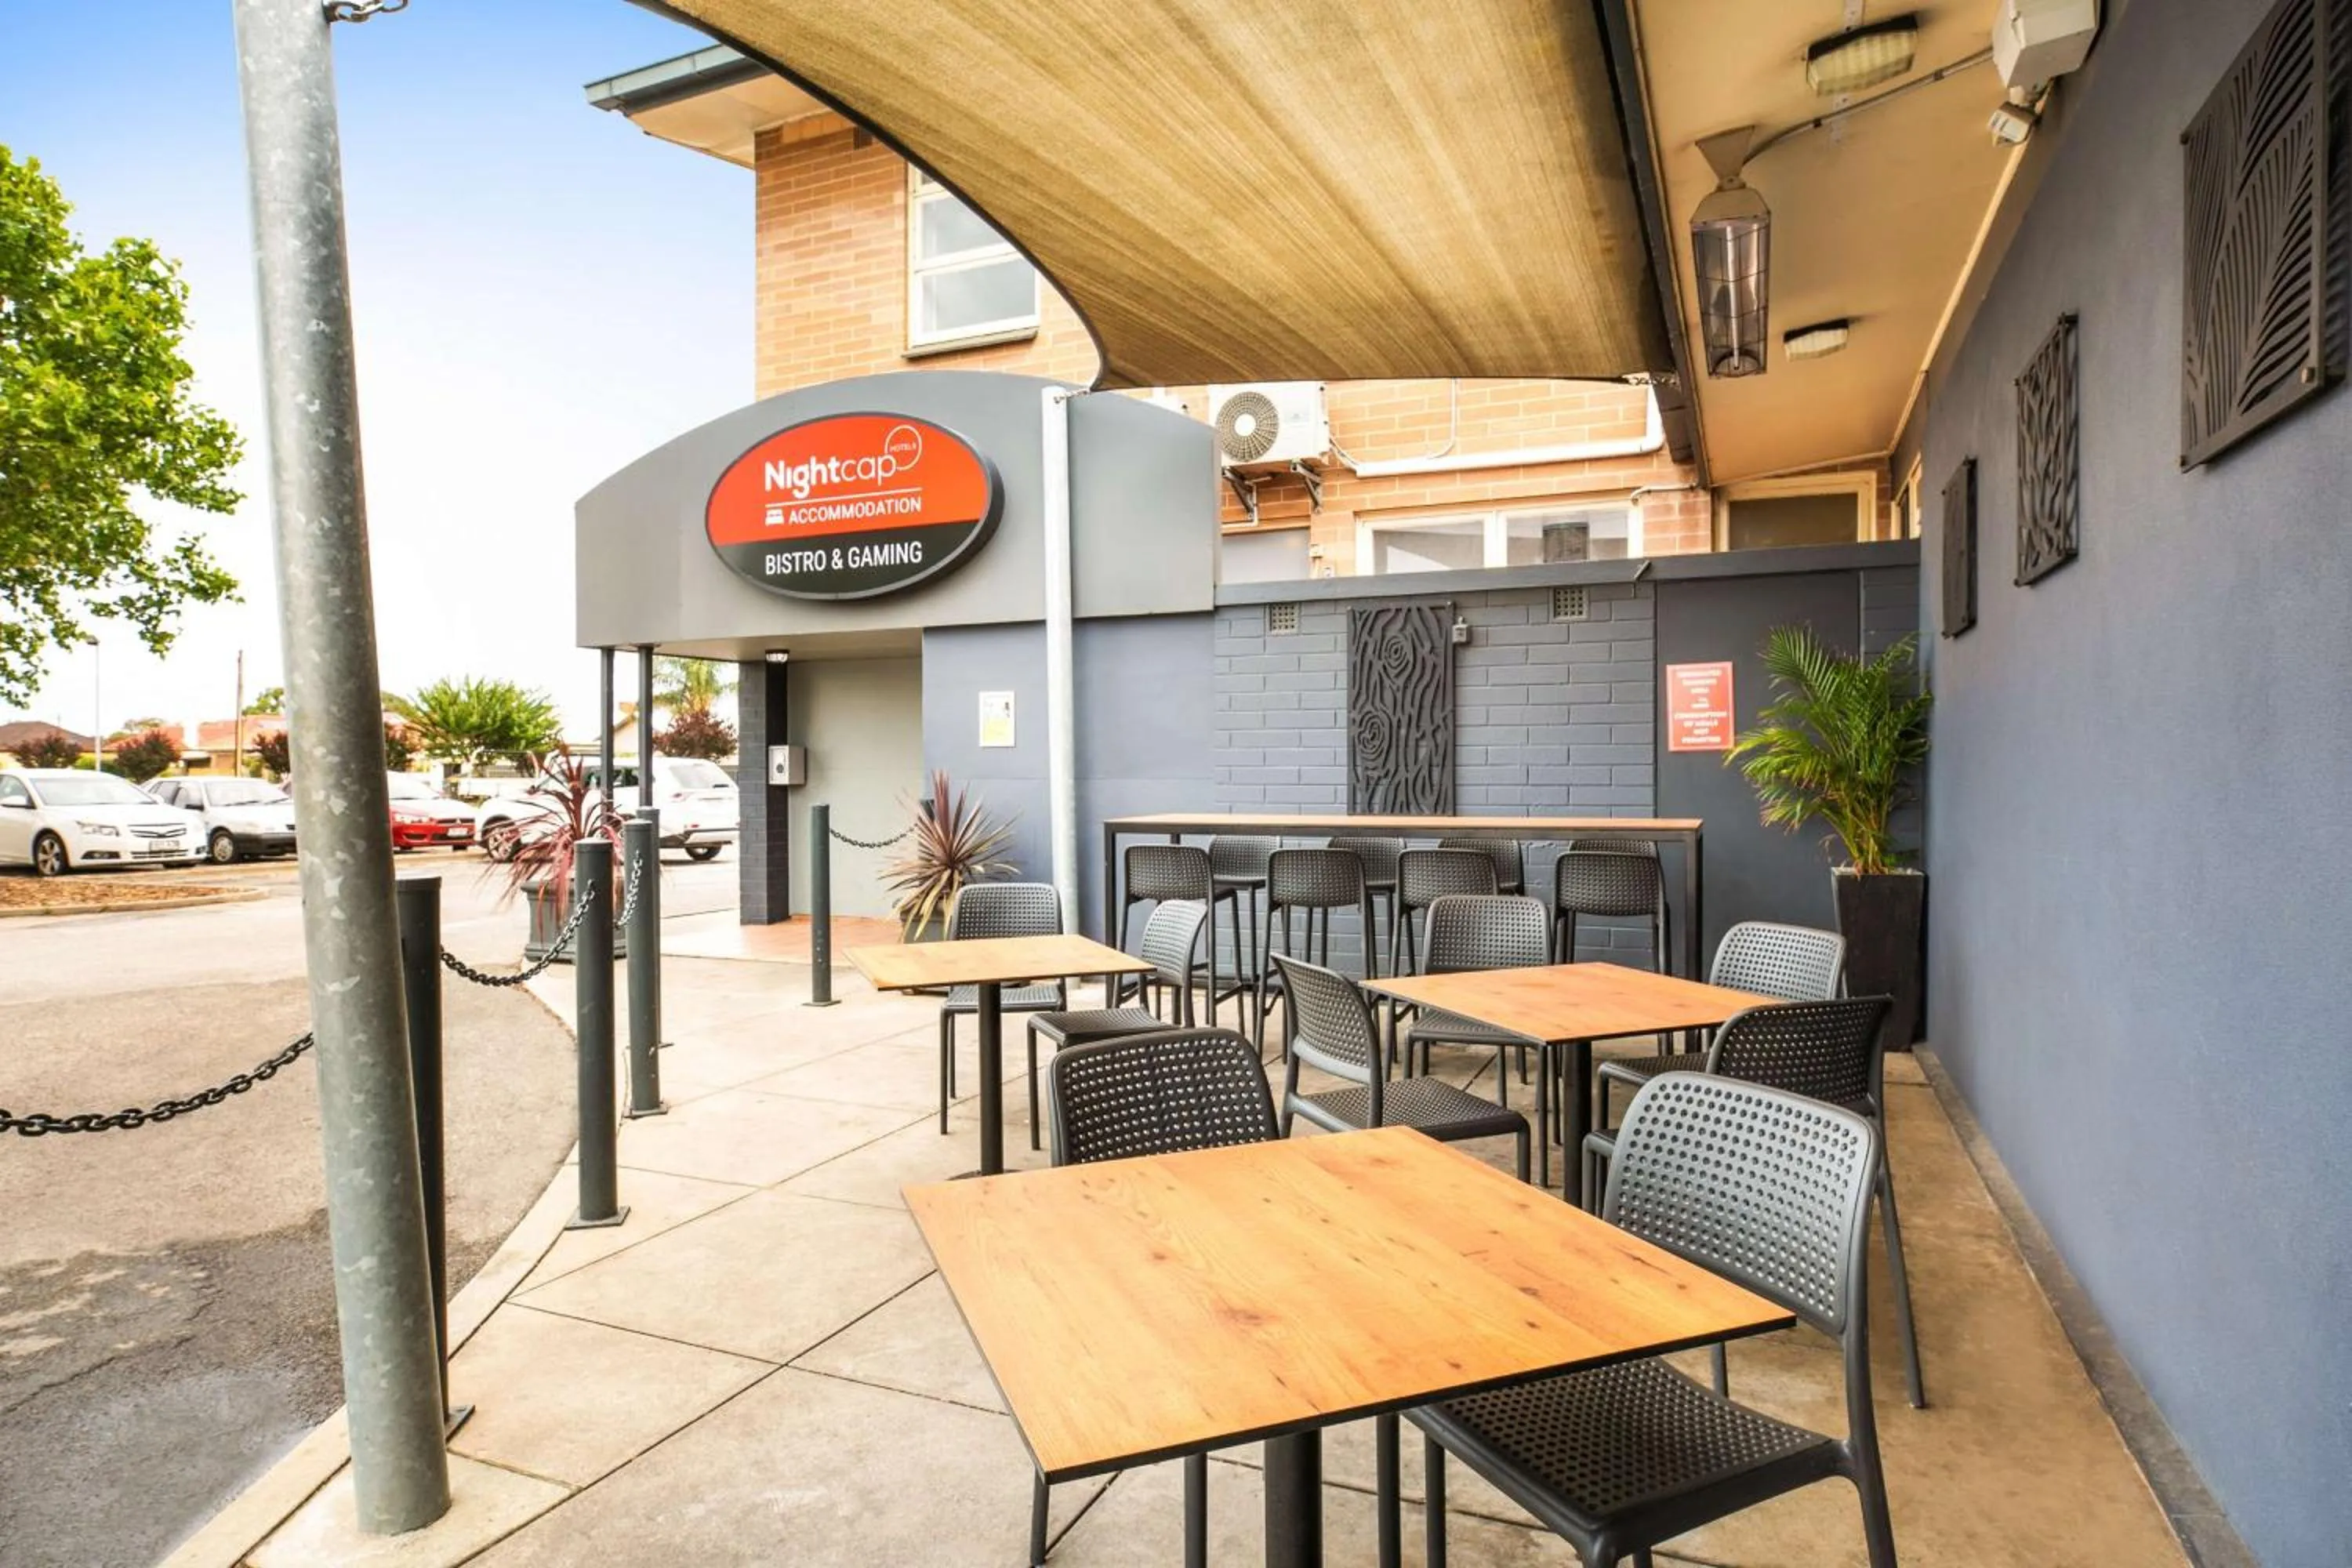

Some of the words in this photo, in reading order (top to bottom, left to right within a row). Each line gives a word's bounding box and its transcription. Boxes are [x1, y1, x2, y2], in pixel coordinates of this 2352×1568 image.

[764, 456, 897, 499] Nightcap
[789, 496, 922, 524] ACCOMMODATION
[765, 550, 826, 575] BISTRO
[831, 547, 844, 570] &
[848, 540, 923, 568] GAMING
